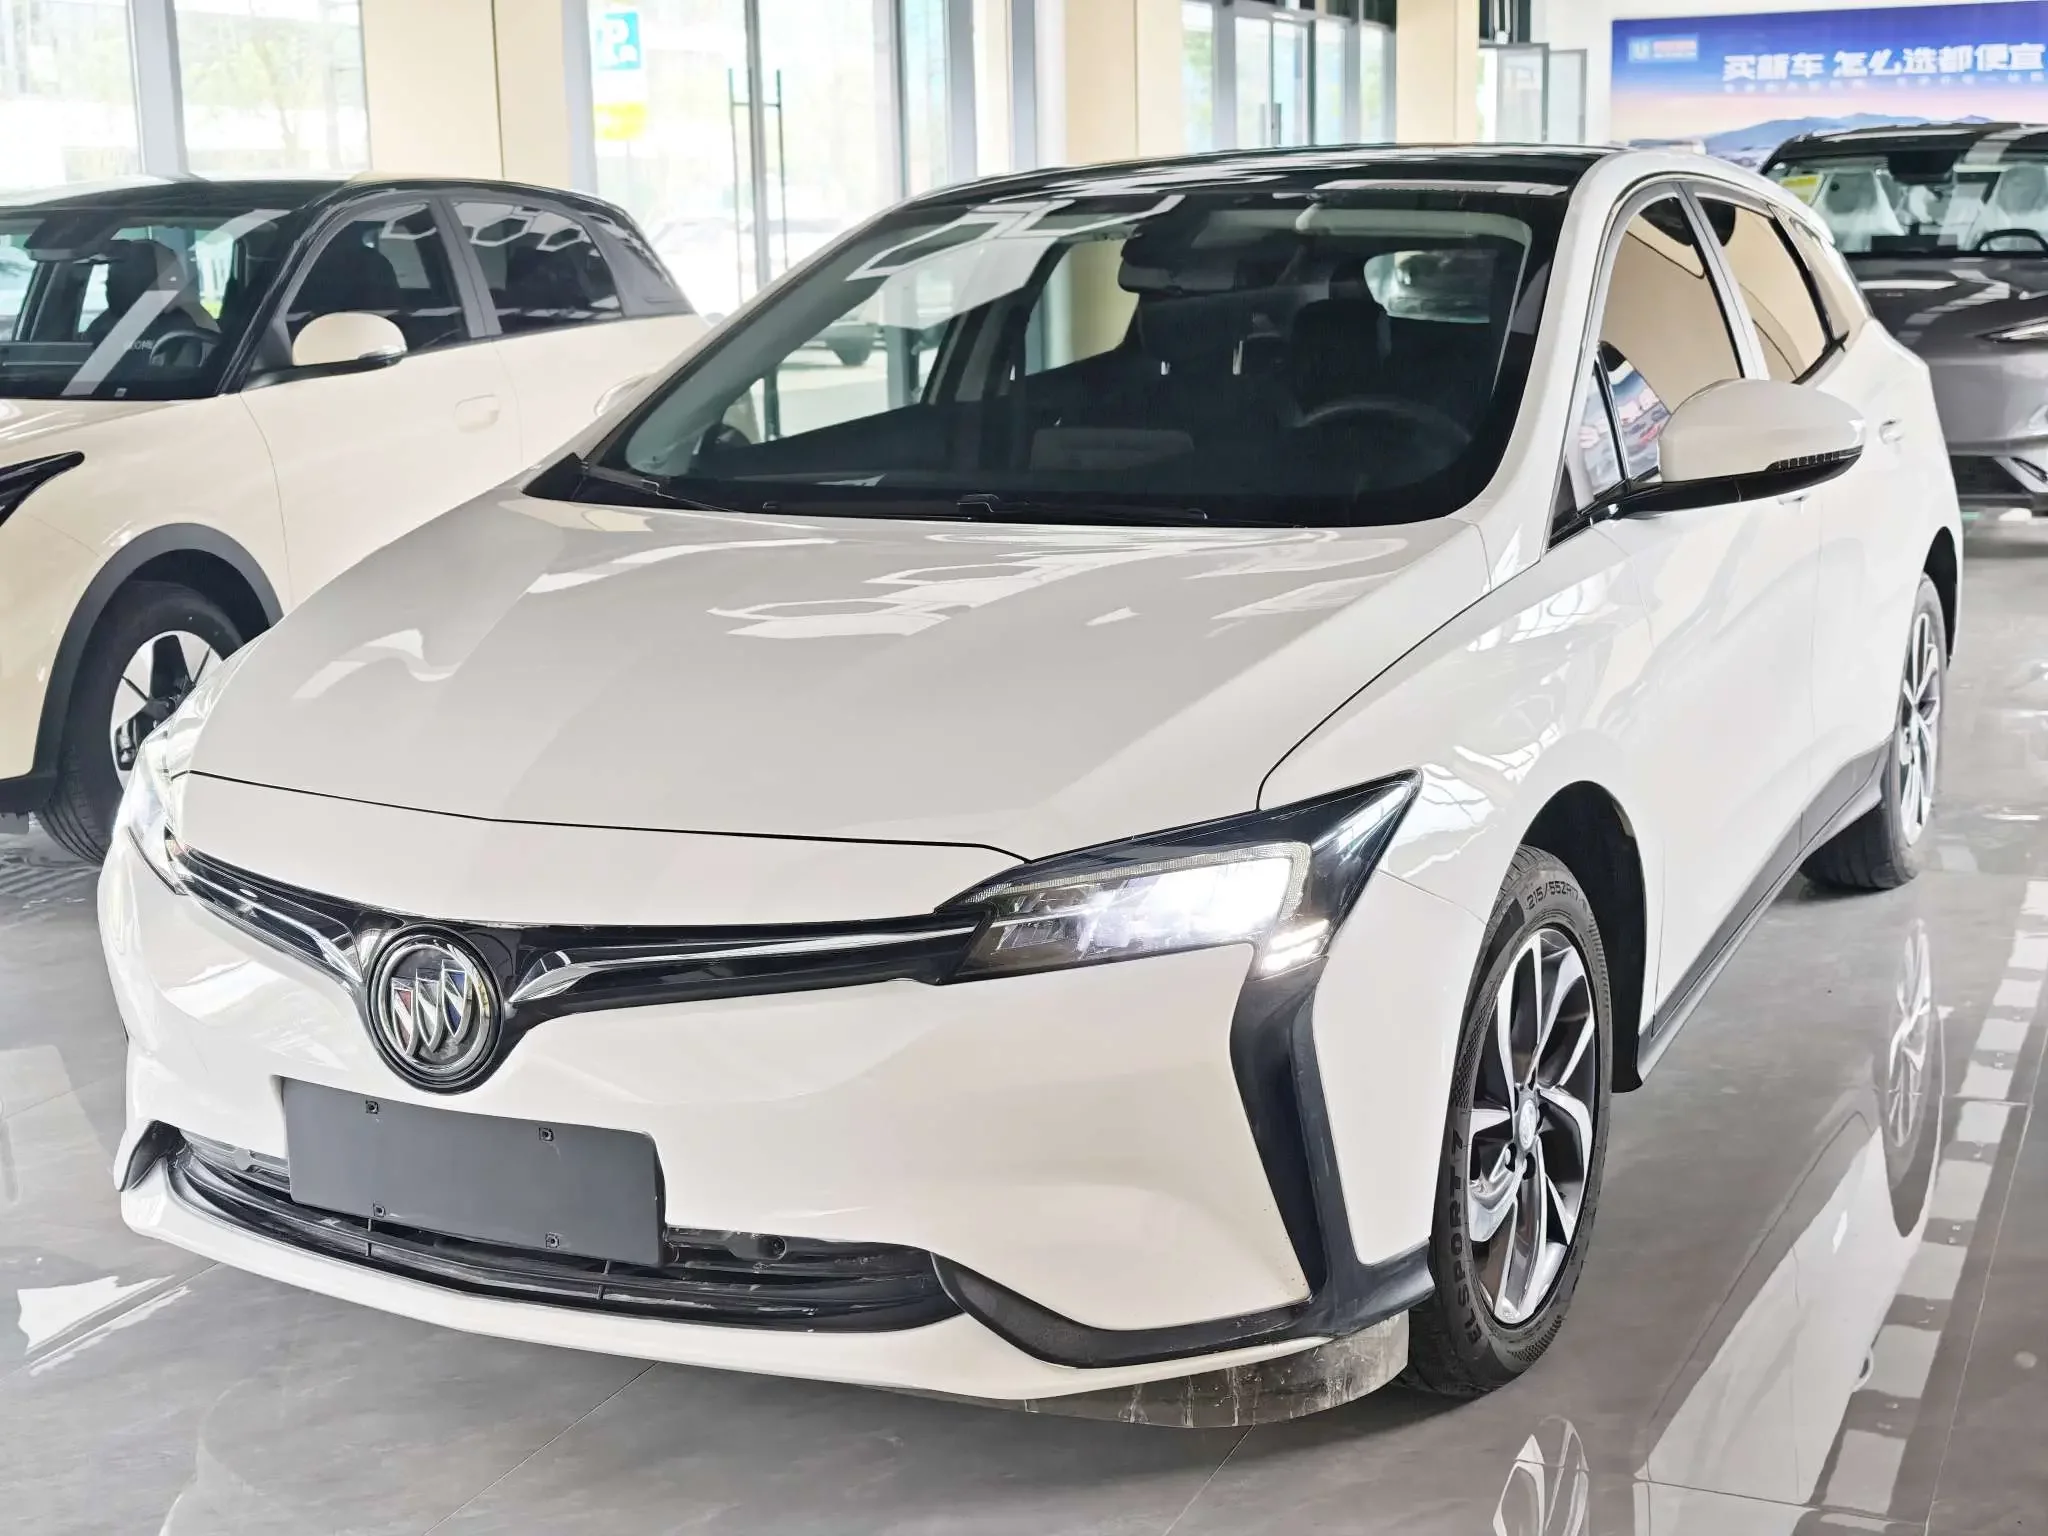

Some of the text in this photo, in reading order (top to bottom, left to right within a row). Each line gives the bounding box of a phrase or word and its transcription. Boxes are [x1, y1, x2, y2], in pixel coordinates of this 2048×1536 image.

[1722, 42, 2046, 82] 买新车 怎么选都便宜
